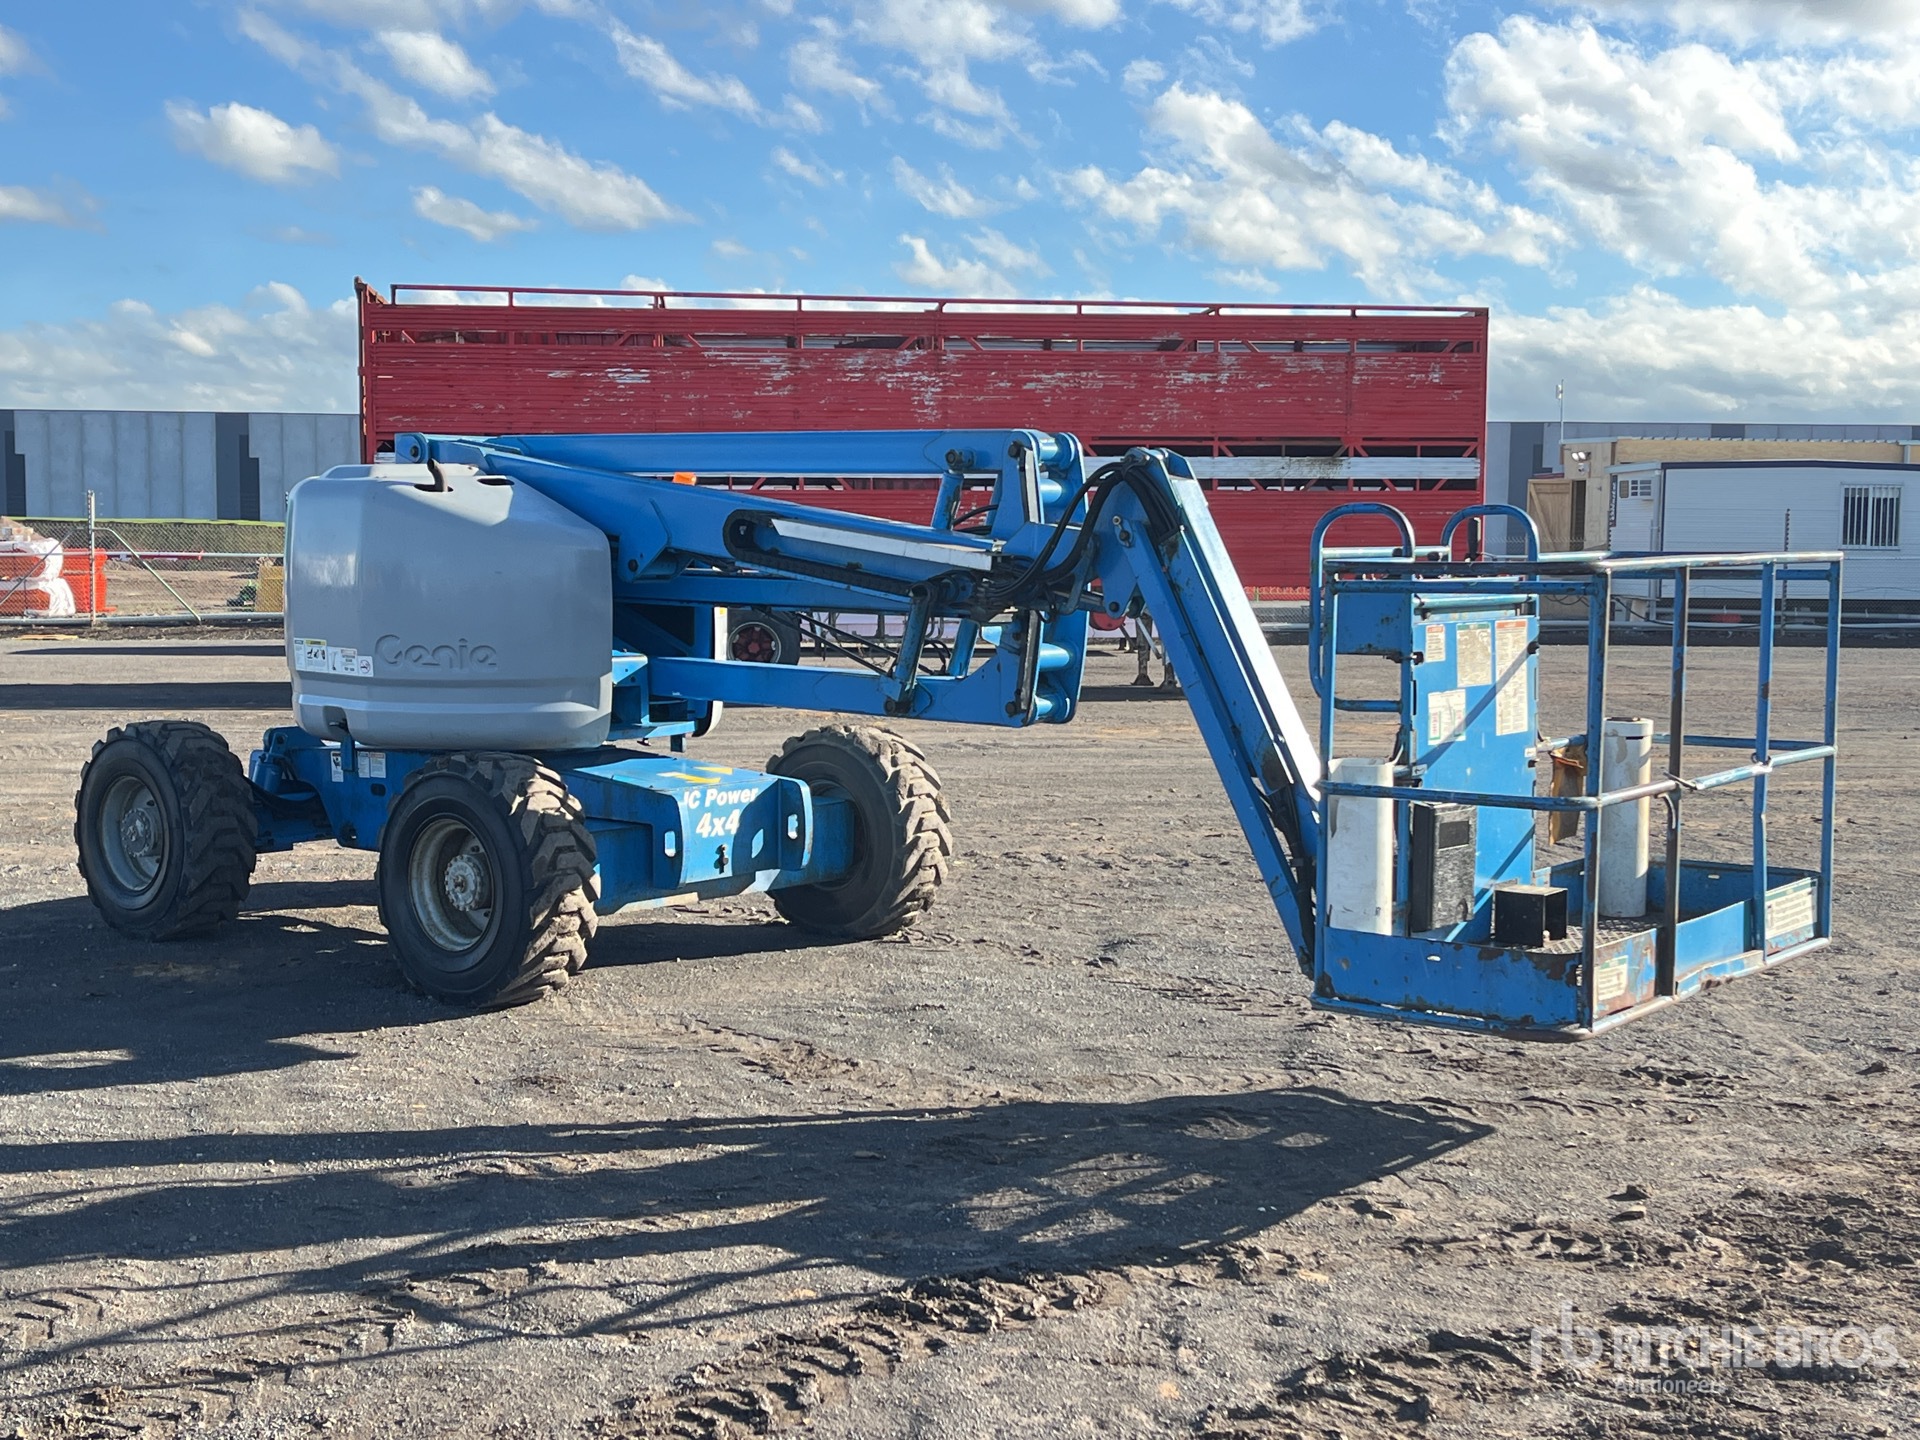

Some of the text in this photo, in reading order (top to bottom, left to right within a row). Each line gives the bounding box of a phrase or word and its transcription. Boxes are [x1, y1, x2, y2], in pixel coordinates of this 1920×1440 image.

[375, 634, 497, 673] Genie
[704, 787, 759, 808] Power
[695, 808, 741, 838] 4x4
